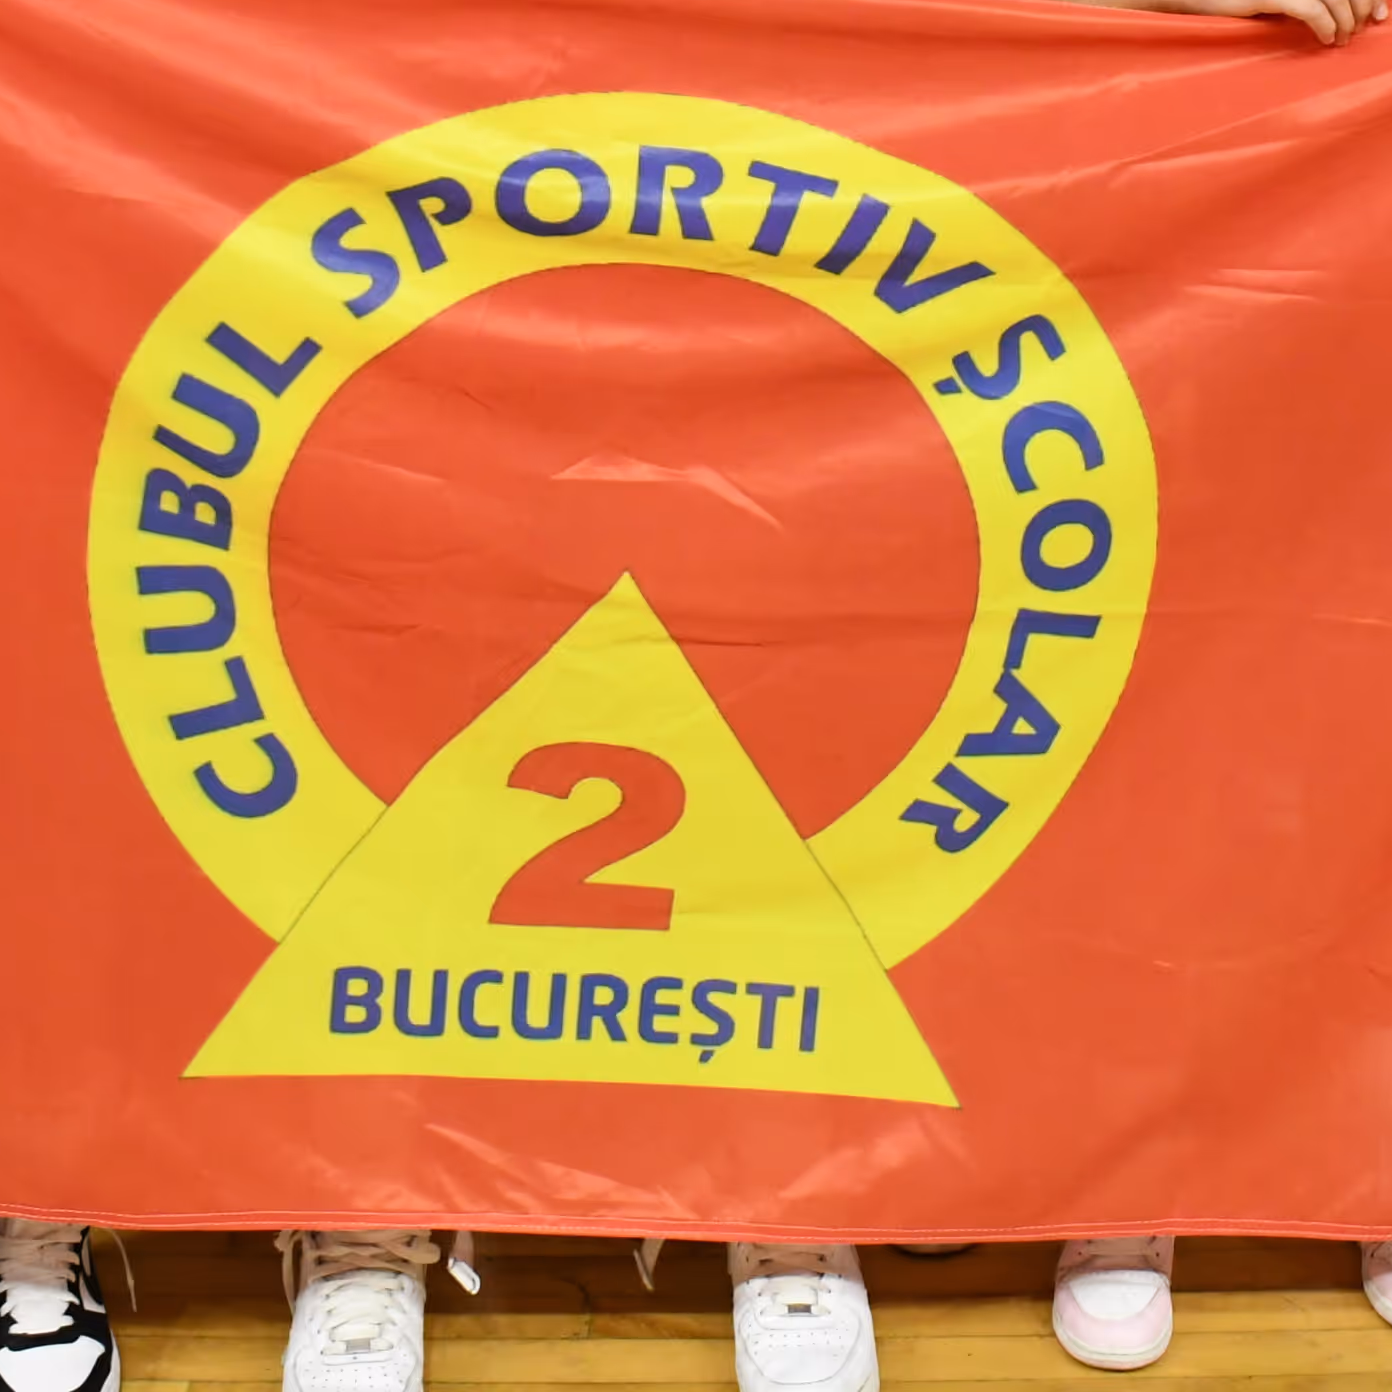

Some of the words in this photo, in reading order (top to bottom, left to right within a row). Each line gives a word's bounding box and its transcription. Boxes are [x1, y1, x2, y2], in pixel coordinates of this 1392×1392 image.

[311, 145, 995, 316] SPORTIV
[135, 324, 320, 819] CLUBUL
[899, 313, 1112, 854] ȘCOLAR
[487, 741, 687, 931] 2
[328, 965, 820, 1063] BUCUREȘTI
